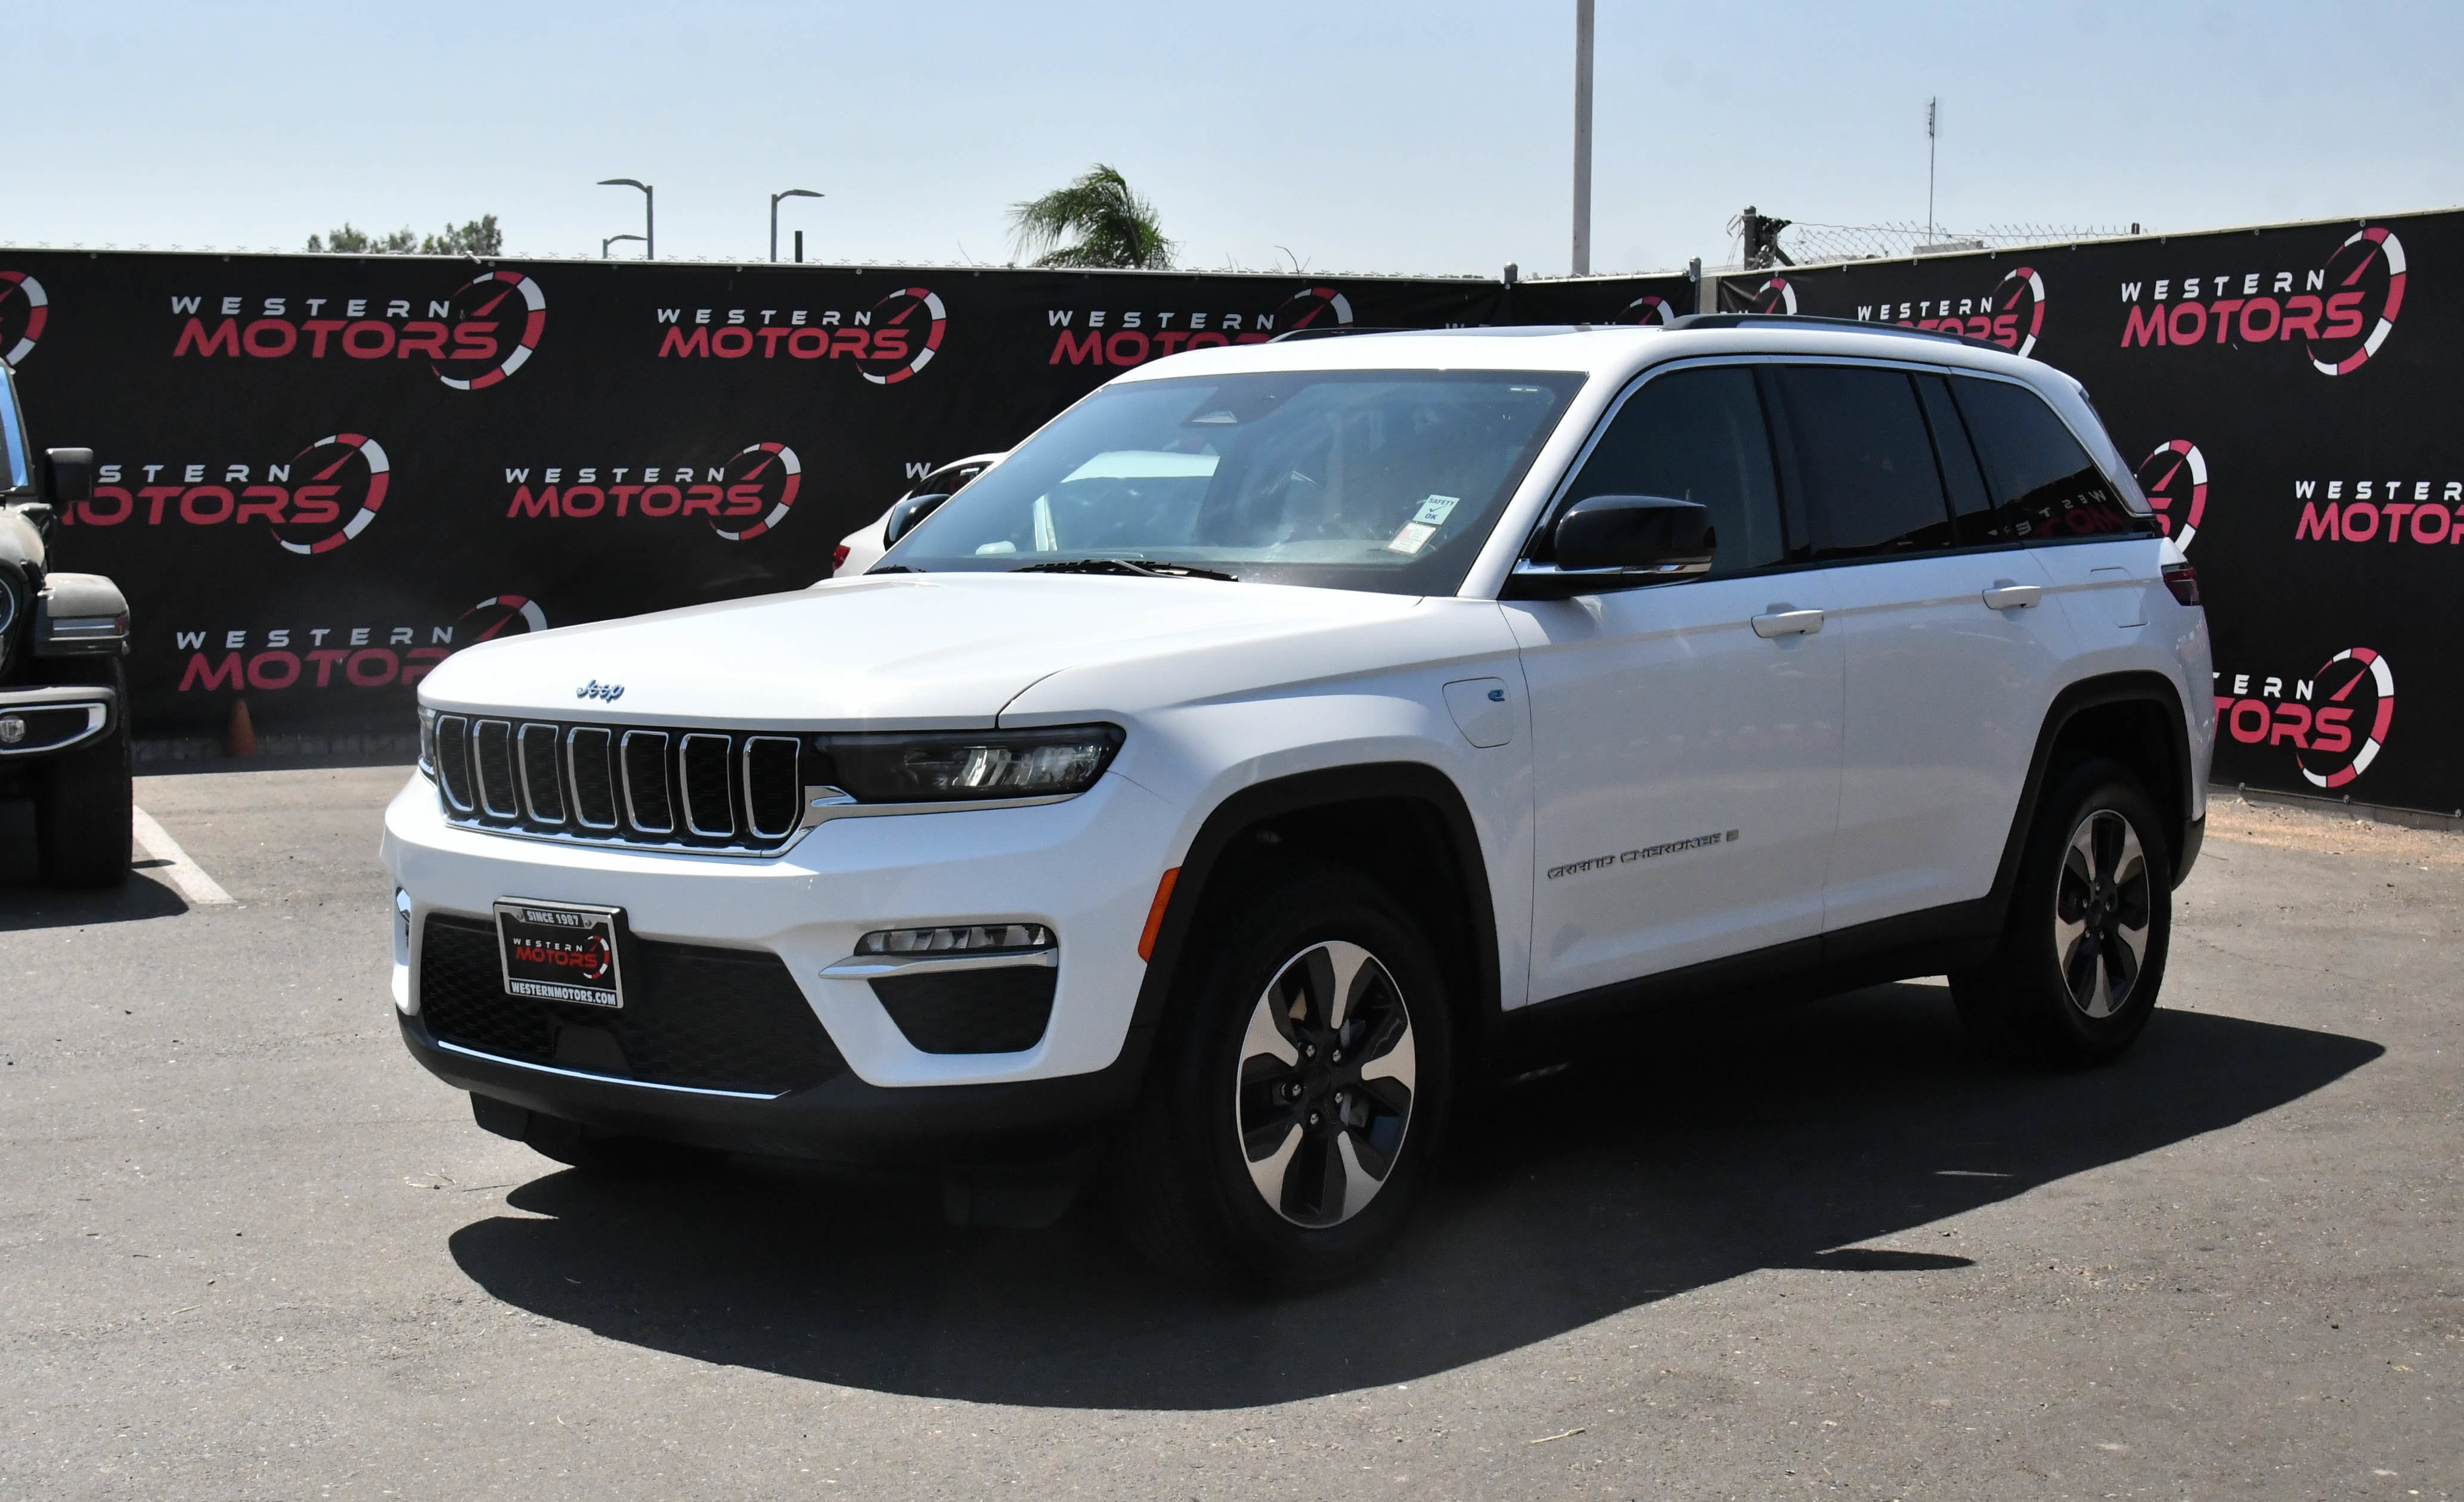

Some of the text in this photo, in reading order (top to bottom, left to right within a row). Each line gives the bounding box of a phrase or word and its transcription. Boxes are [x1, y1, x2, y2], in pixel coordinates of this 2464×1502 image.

[2121, 269, 2325, 302] WESTERN
[172, 296, 450, 318] WESTERN
[658, 308, 872, 326] WESTERN
[1857, 296, 1993, 322] WESTERN
[2121, 291, 2365, 347] MOTORS
[1048, 310, 1275, 330] WESTERN
[173, 318, 498, 359] MOTORS
[659, 326, 910, 359] MOTORS
[1049, 330, 1271, 365] MOT
[98, 464, 290, 483] STERN
[505, 467, 725, 484] WESTERN
[507, 484, 763, 517] MOTORS
[1428, 498, 1456, 506] SAFETY
[2295, 480, 2463, 501] WESTER
[61, 485, 342, 526] OTORS
[2296, 502, 2464, 545] MOTO
[176, 626, 453, 650] WESTERN
[179, 648, 452, 691] MOTOR
[576, 679, 625, 704] Jeep
[2214, 696, 2354, 753] TORS
[1548, 833, 1722, 880] GRAND CHEROKEE
[526, 911, 579, 926] SINCE 1987
[513, 938, 583, 952] WESTERN
[515, 946, 599, 968] MOTORS
[511, 982, 616, 1006] WESTERNMOTORS.COM
